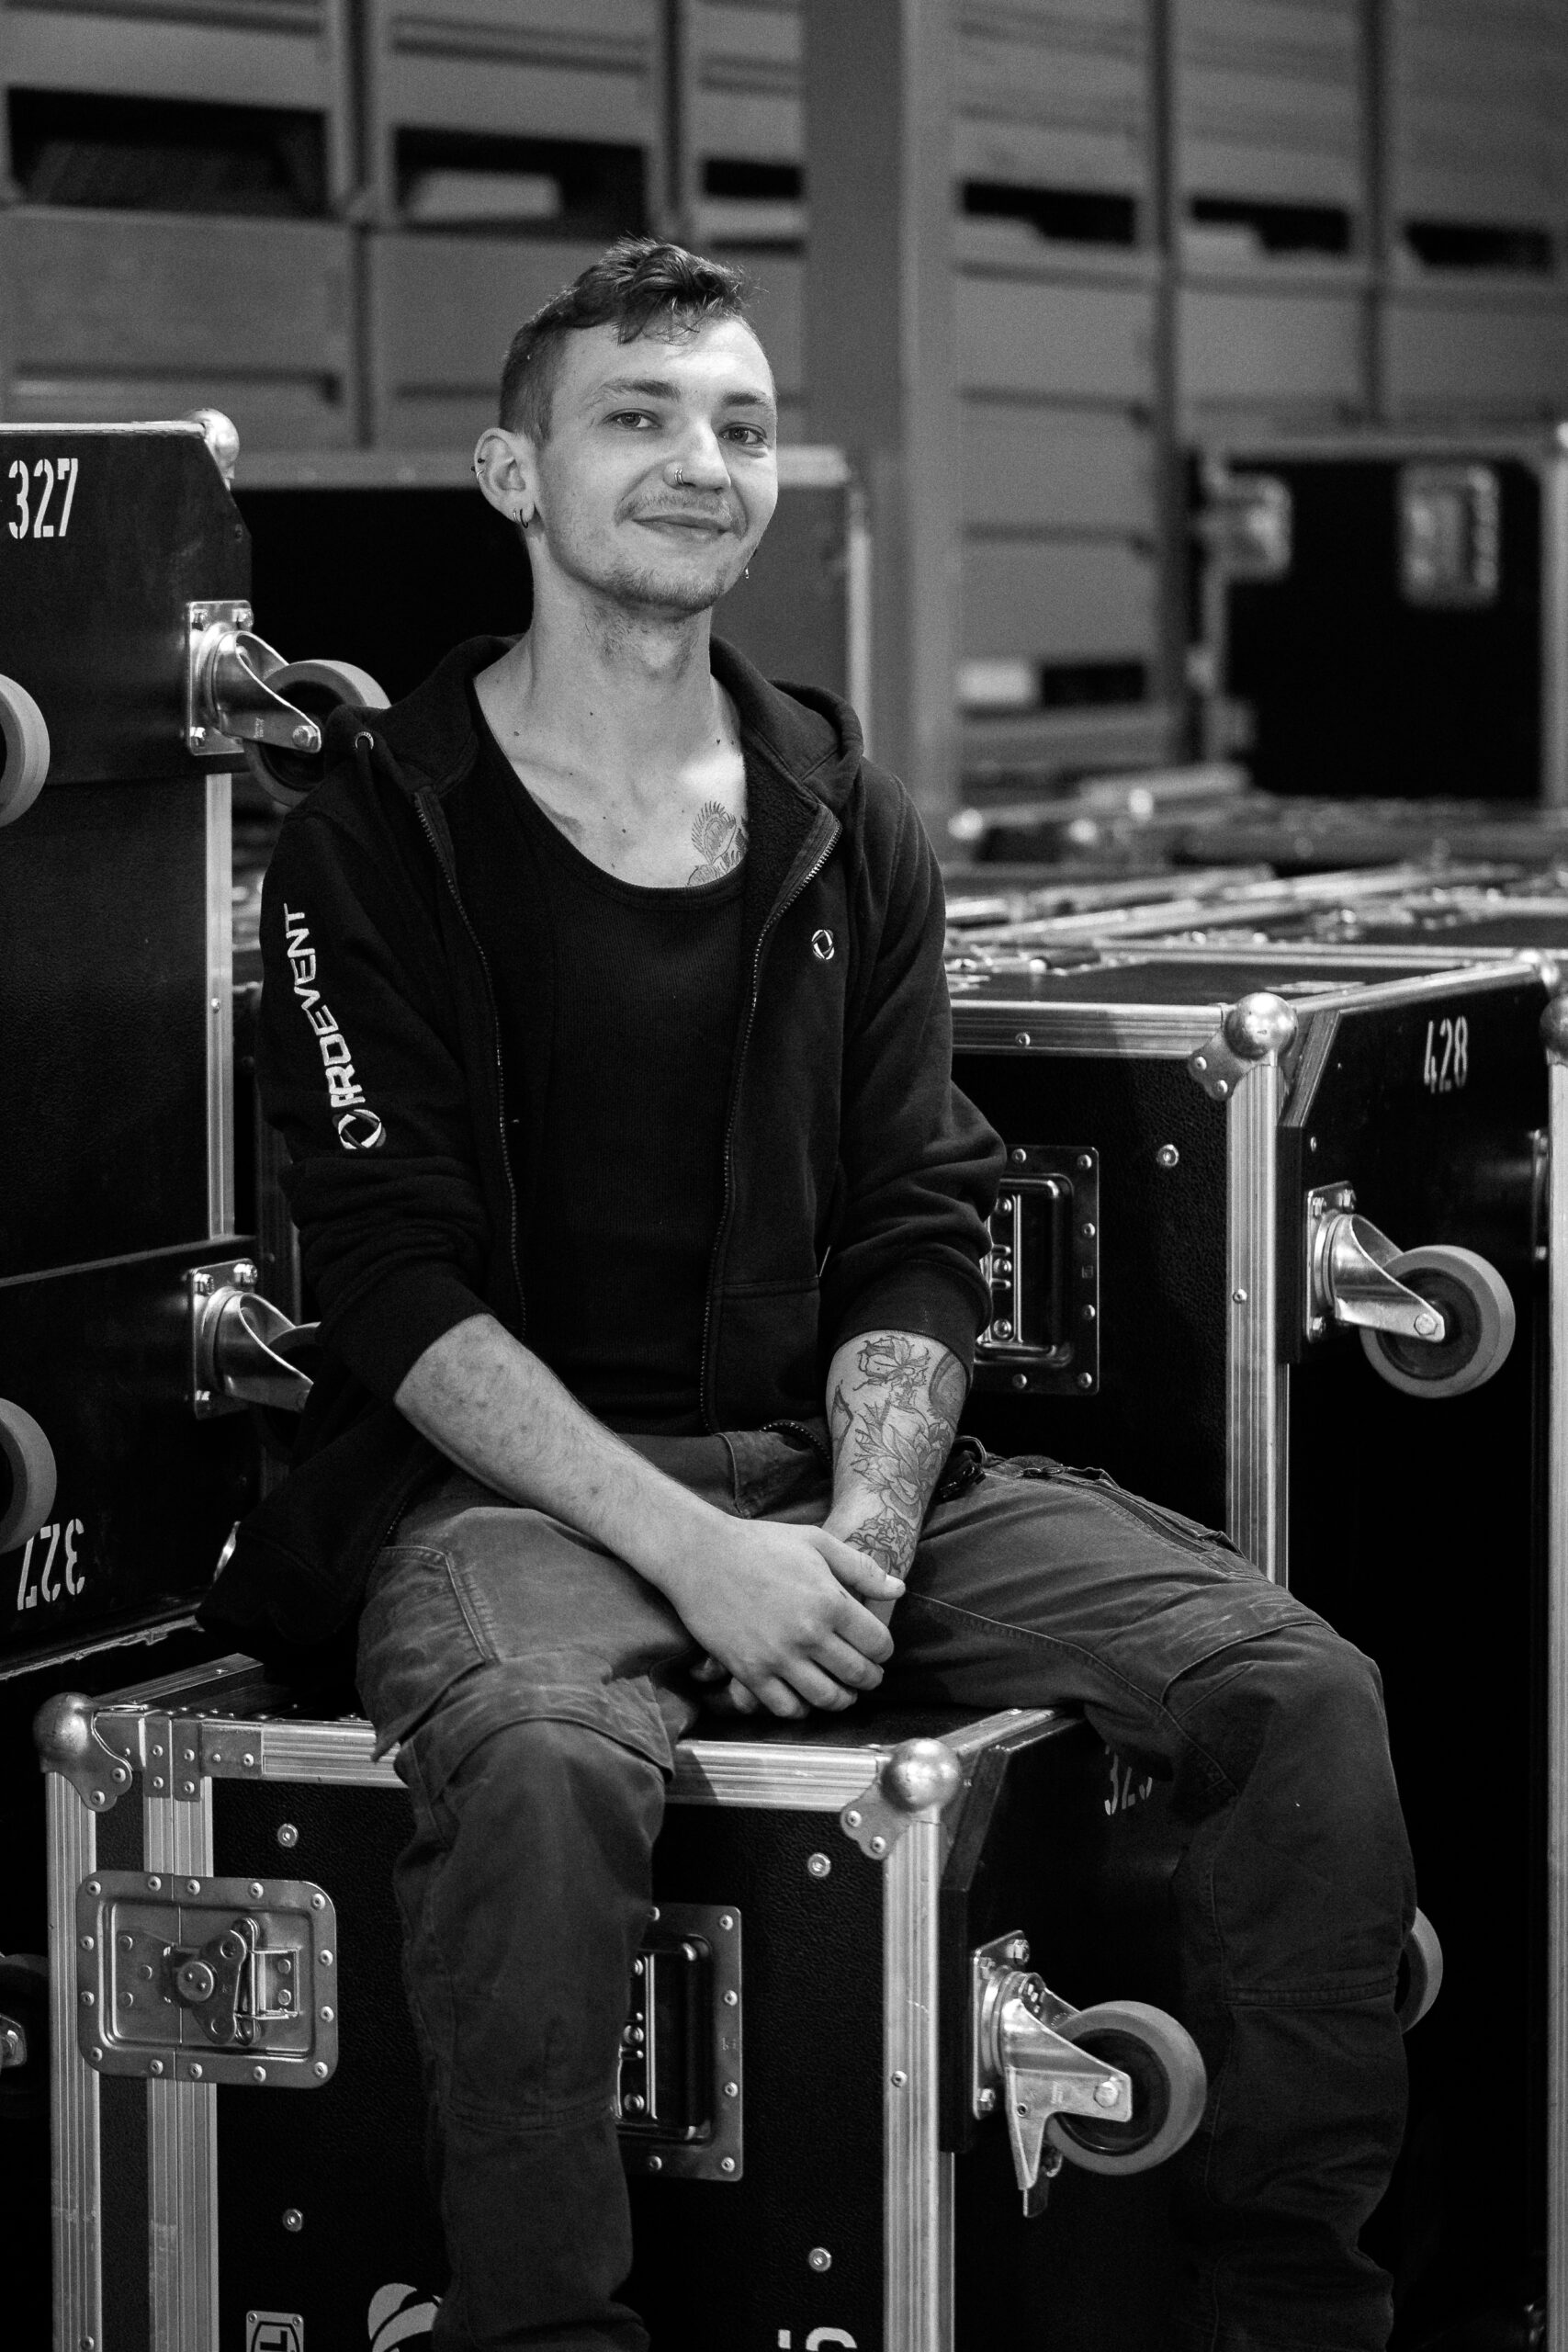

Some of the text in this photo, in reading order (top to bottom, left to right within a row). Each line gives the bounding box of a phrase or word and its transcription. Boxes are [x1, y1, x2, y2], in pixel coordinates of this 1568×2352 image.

[7, 458, 79, 539] 327
[1423, 1014, 1470, 1095] 428
[17, 1517, 85, 1611] 327
